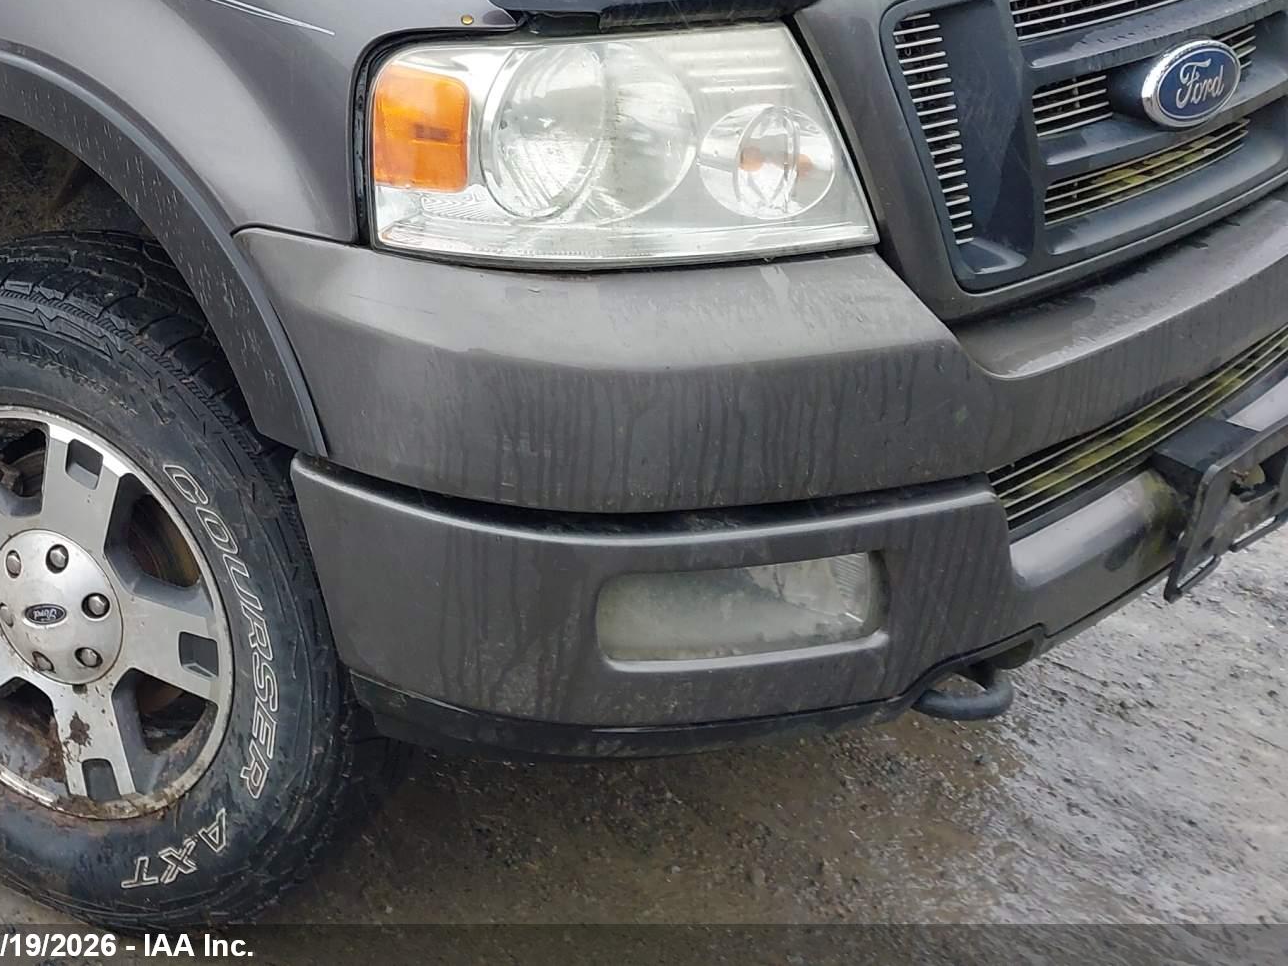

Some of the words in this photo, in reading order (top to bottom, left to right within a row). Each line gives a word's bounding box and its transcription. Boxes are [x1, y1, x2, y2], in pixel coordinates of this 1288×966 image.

[1175, 58, 1225, 109] Ford
[164, 463, 280, 799] COURSER
[121, 809, 228, 889] AXT
